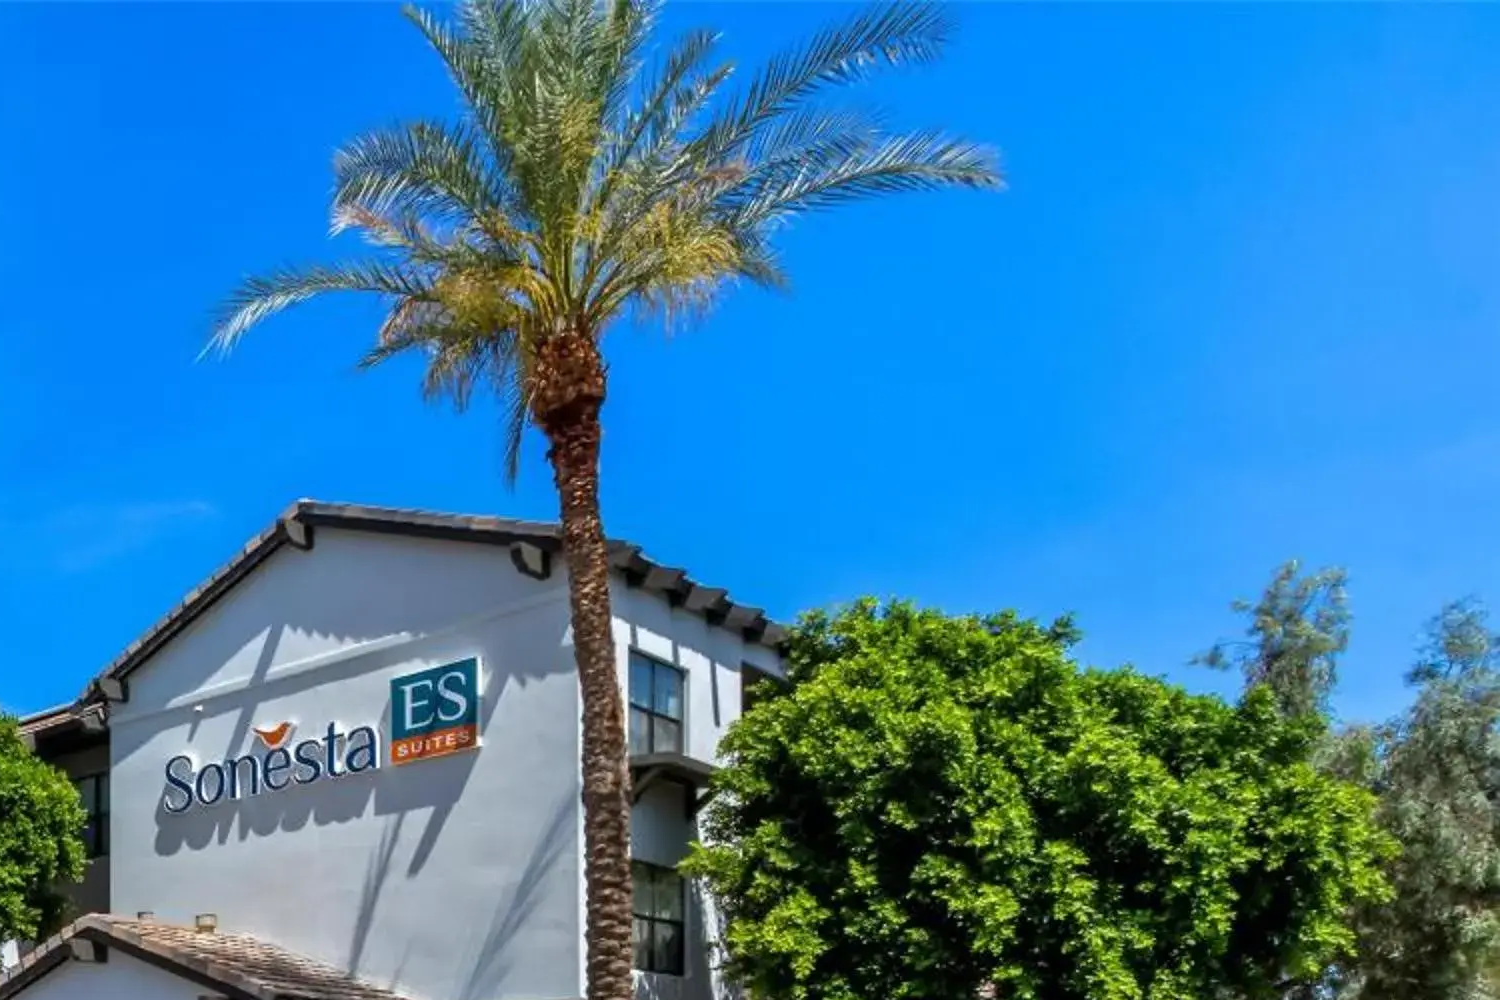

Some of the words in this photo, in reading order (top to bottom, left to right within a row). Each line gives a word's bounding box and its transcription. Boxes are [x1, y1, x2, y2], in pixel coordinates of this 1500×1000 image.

[400, 670, 468, 731] ES
[164, 720, 378, 814] Sonesta
[396, 729, 471, 758] SUITES
